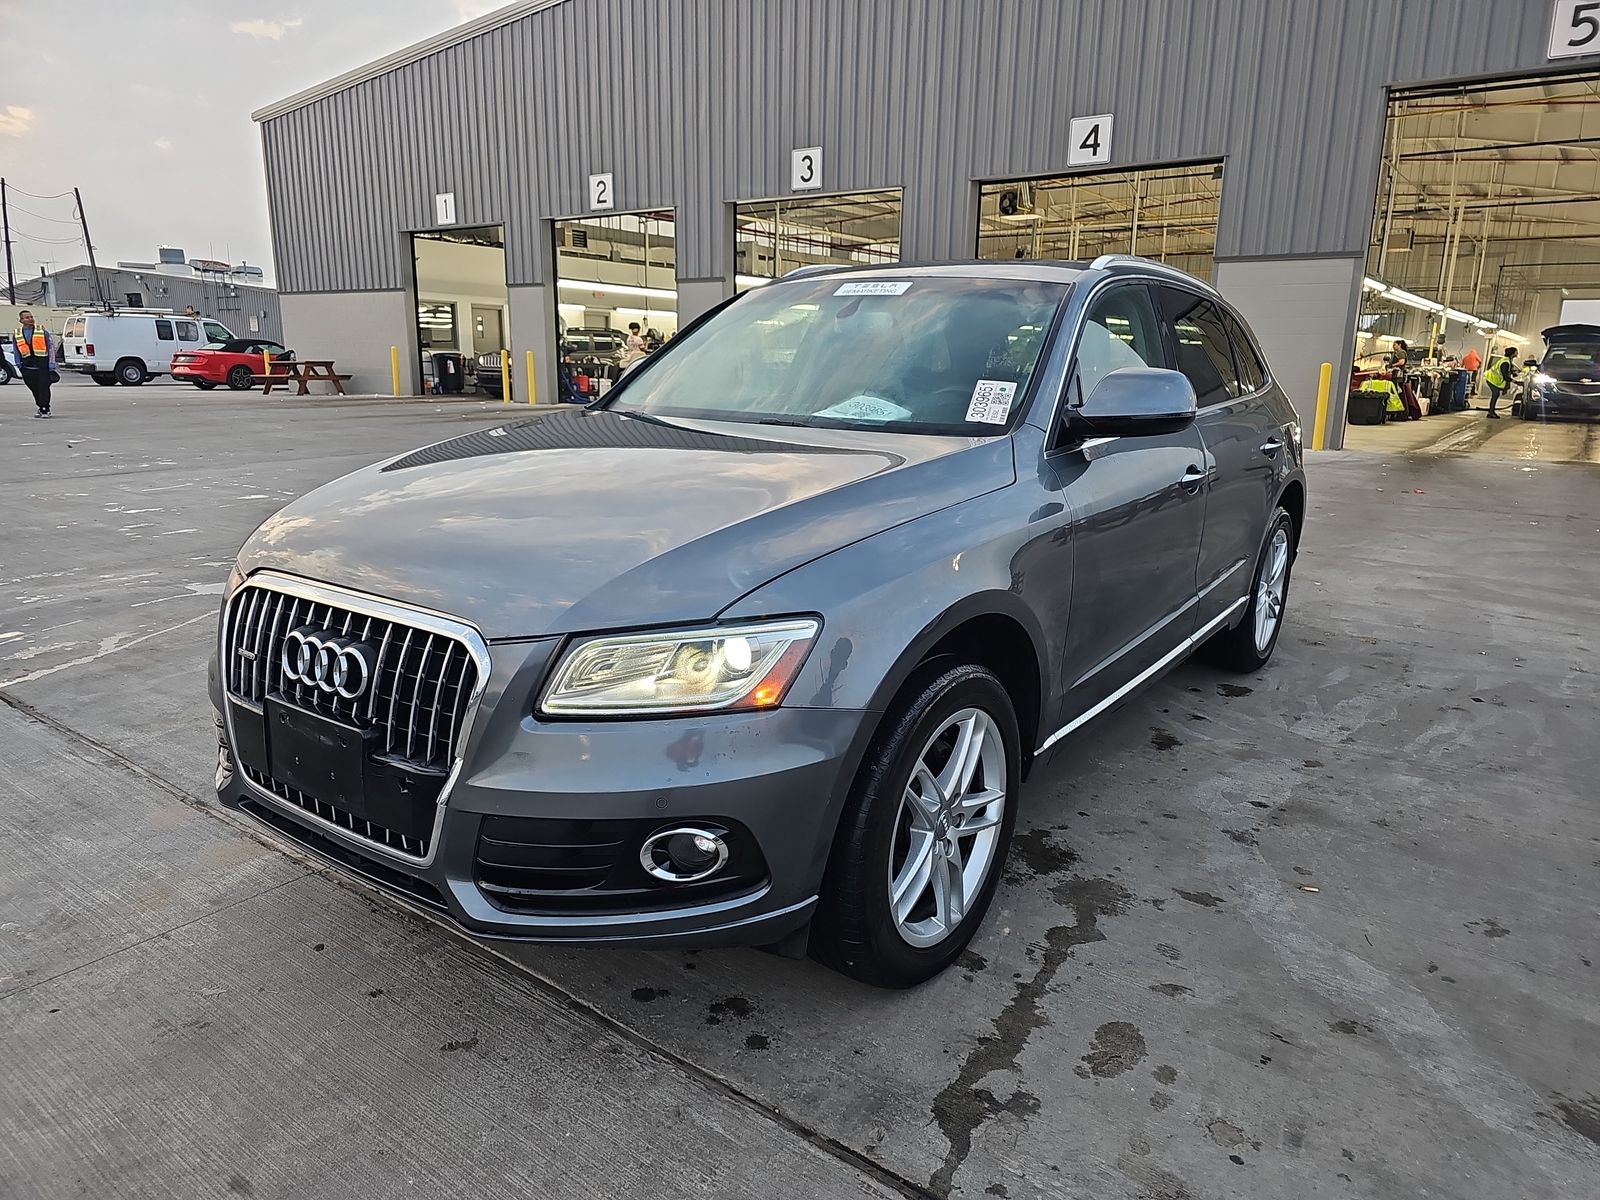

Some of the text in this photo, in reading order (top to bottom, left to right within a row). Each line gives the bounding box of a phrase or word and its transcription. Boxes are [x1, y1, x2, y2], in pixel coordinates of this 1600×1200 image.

[1567, 2, 1600, 47] 5
[1079, 123, 1101, 157] 4
[800, 155, 814, 183] 3
[596, 180, 607, 204] 2
[443, 199, 448, 219] 1
[970, 382, 994, 418] 3039651
